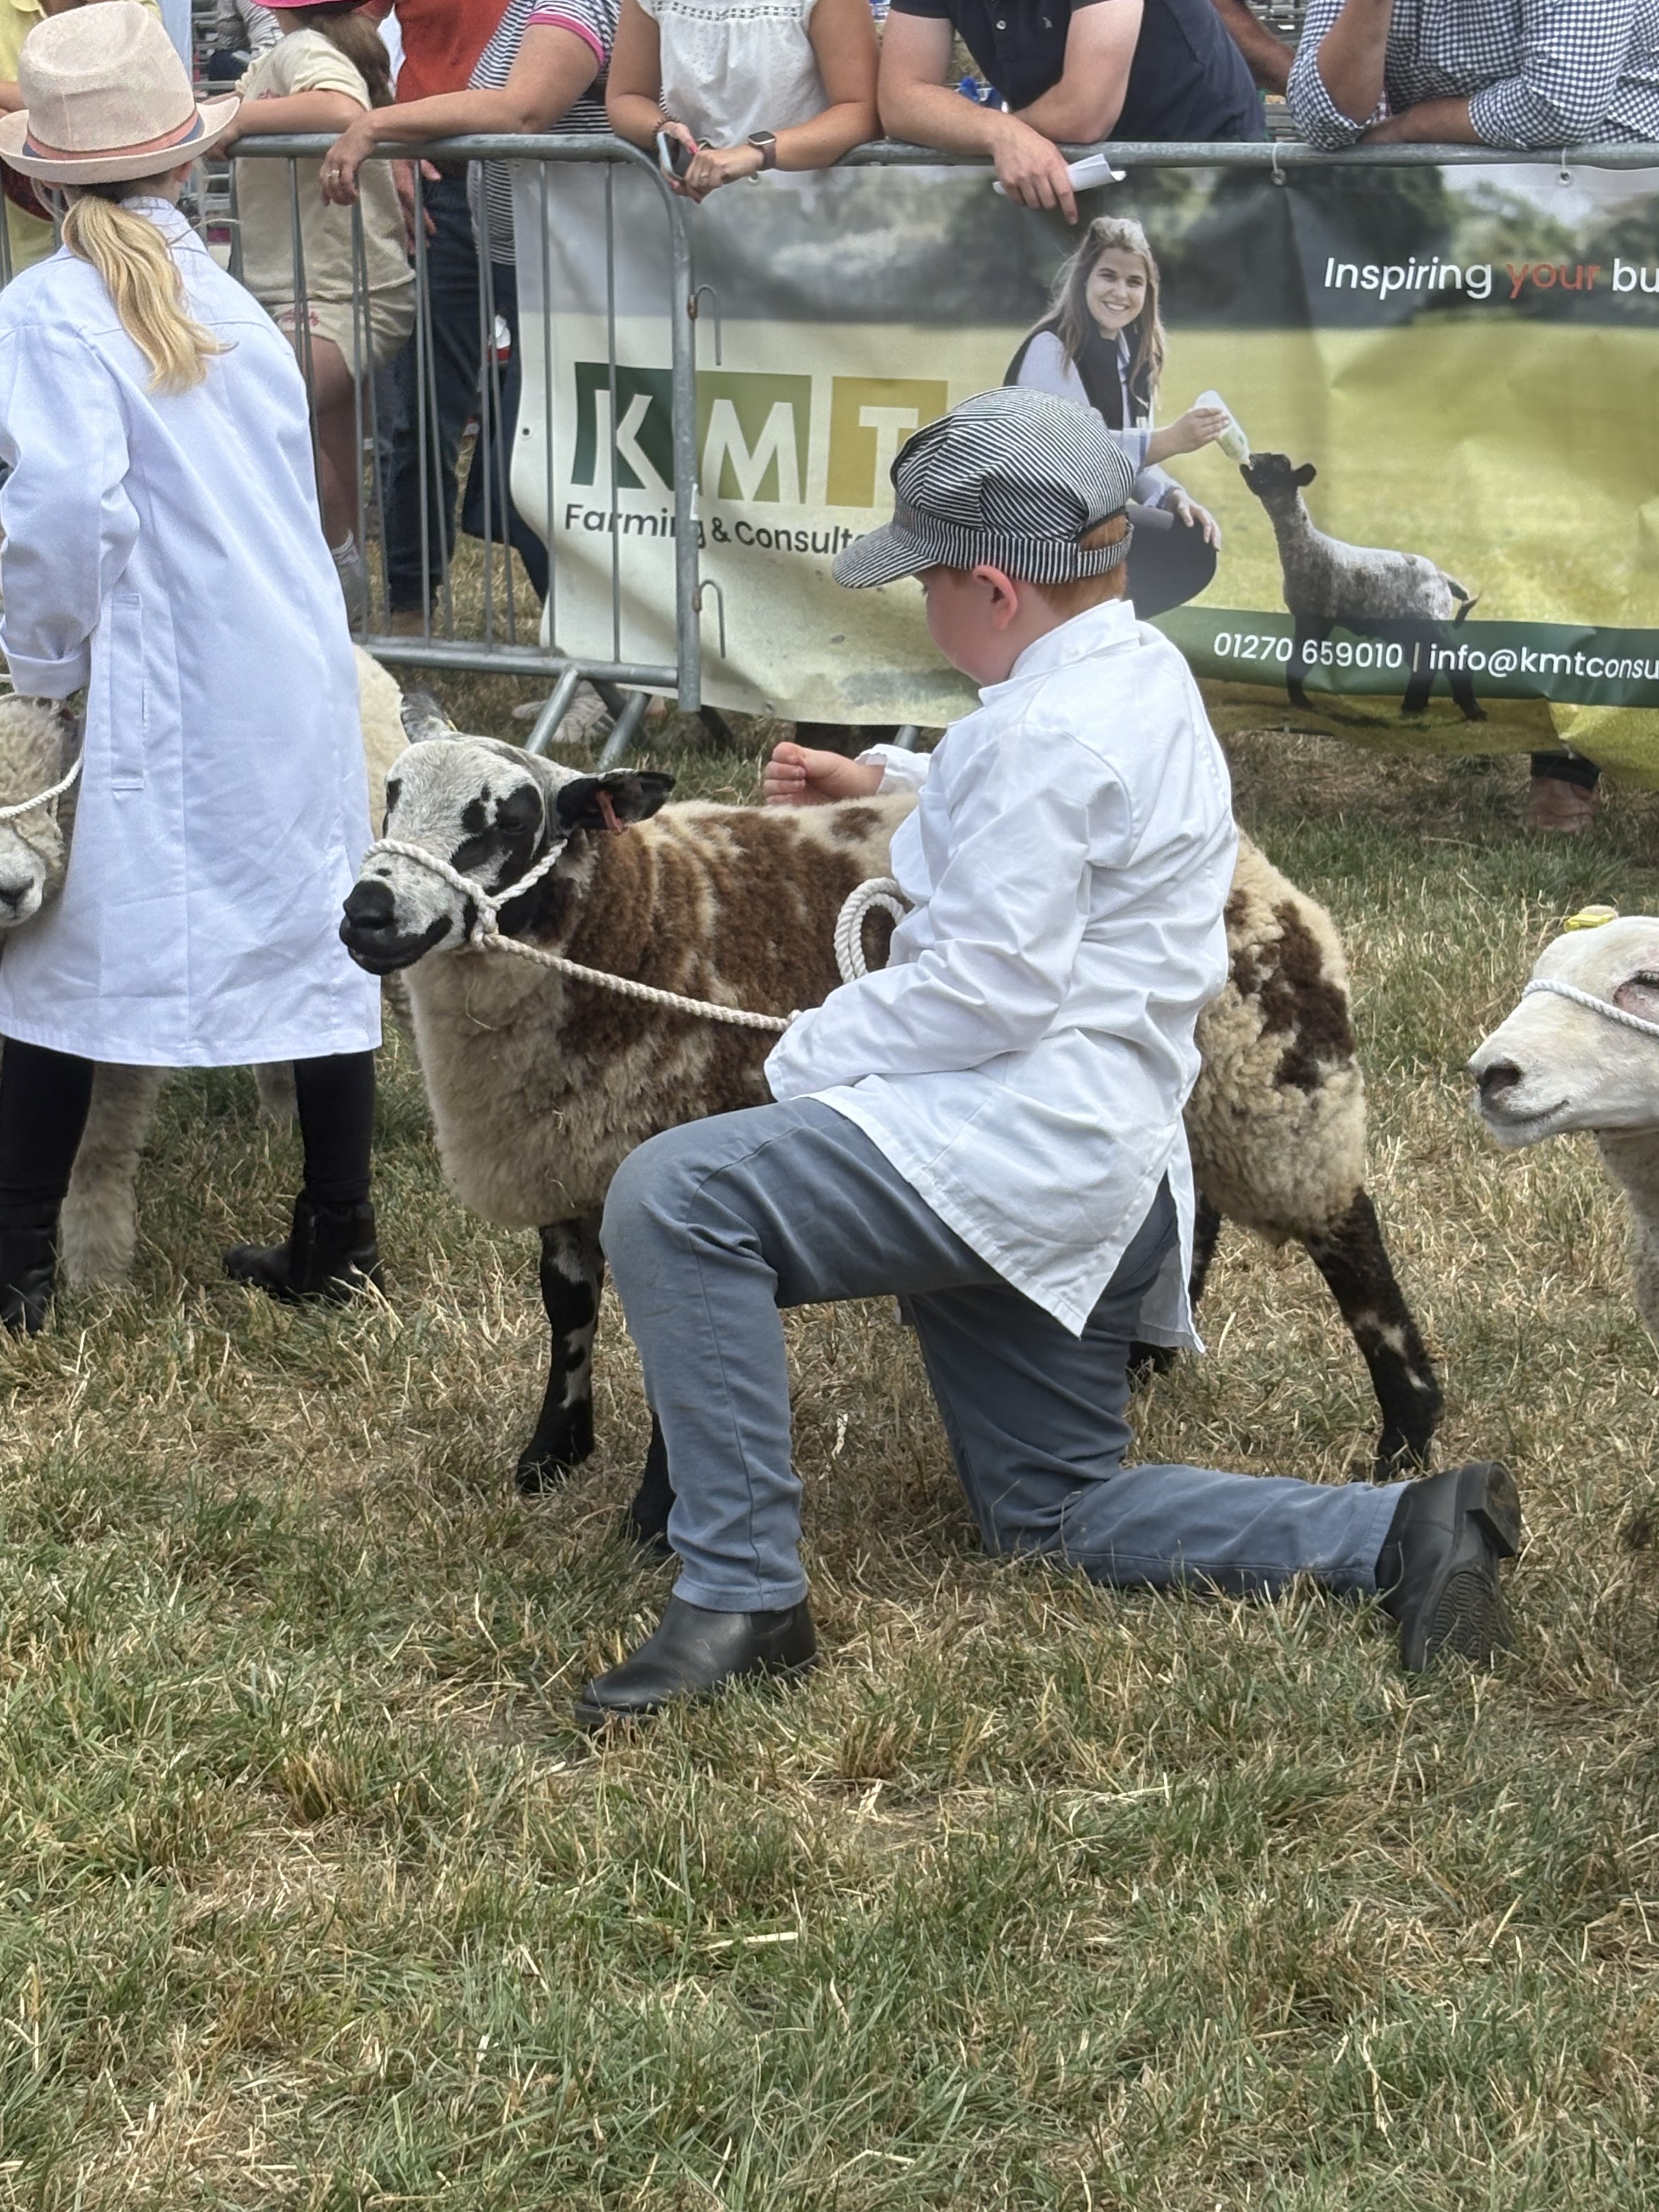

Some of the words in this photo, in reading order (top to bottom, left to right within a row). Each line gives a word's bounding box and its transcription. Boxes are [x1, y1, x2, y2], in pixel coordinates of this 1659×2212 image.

[1324, 256, 1492, 300] Inspiring
[1506, 263, 1601, 299] your
[1612, 258, 1659, 292] bu
[712, 517, 731, 543] &
[735, 521, 865, 554] Consult
[1214, 633, 1293, 662] 01270
[1302, 639, 1402, 668] 659010
[1429, 644, 1659, 680] info@kmtconsu
